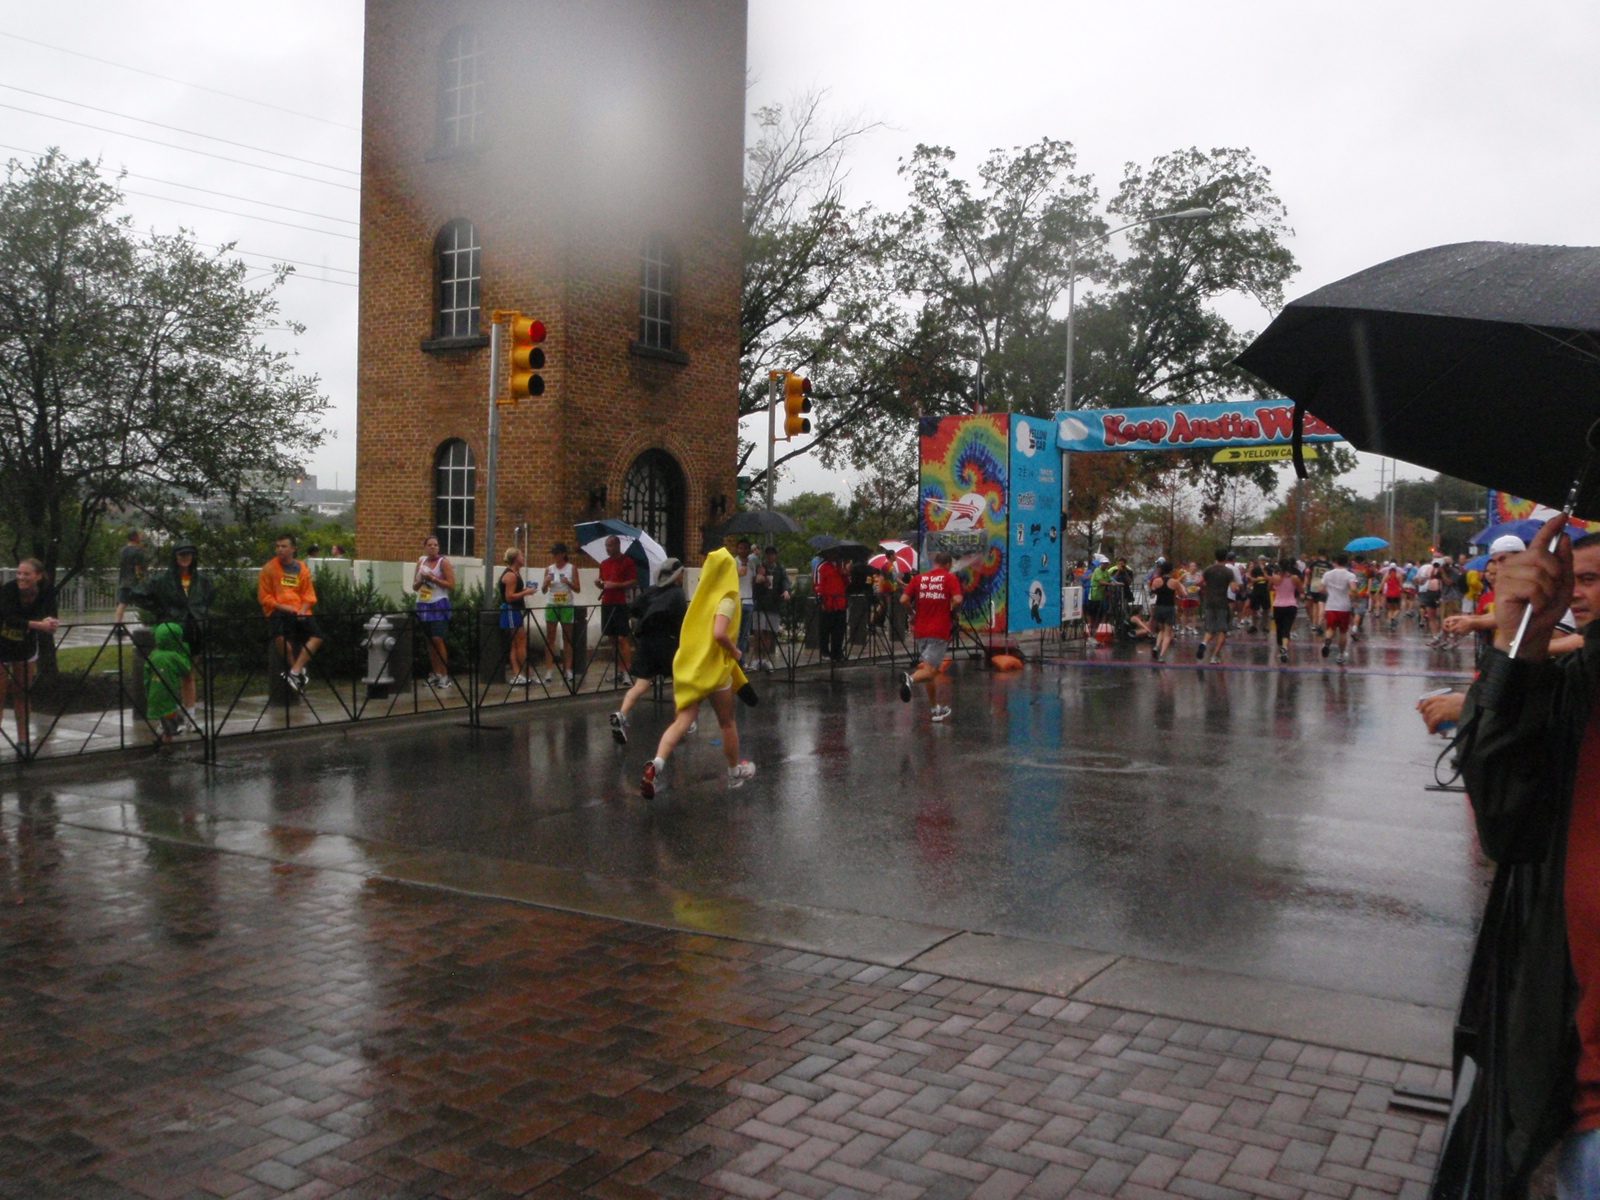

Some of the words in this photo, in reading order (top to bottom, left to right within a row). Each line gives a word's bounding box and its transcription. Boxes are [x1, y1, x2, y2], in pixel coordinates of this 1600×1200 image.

[1102, 414, 1167, 446] Keep
[1168, 411, 1260, 443] Austin
[1243, 450, 1279, 458] YELLOW
